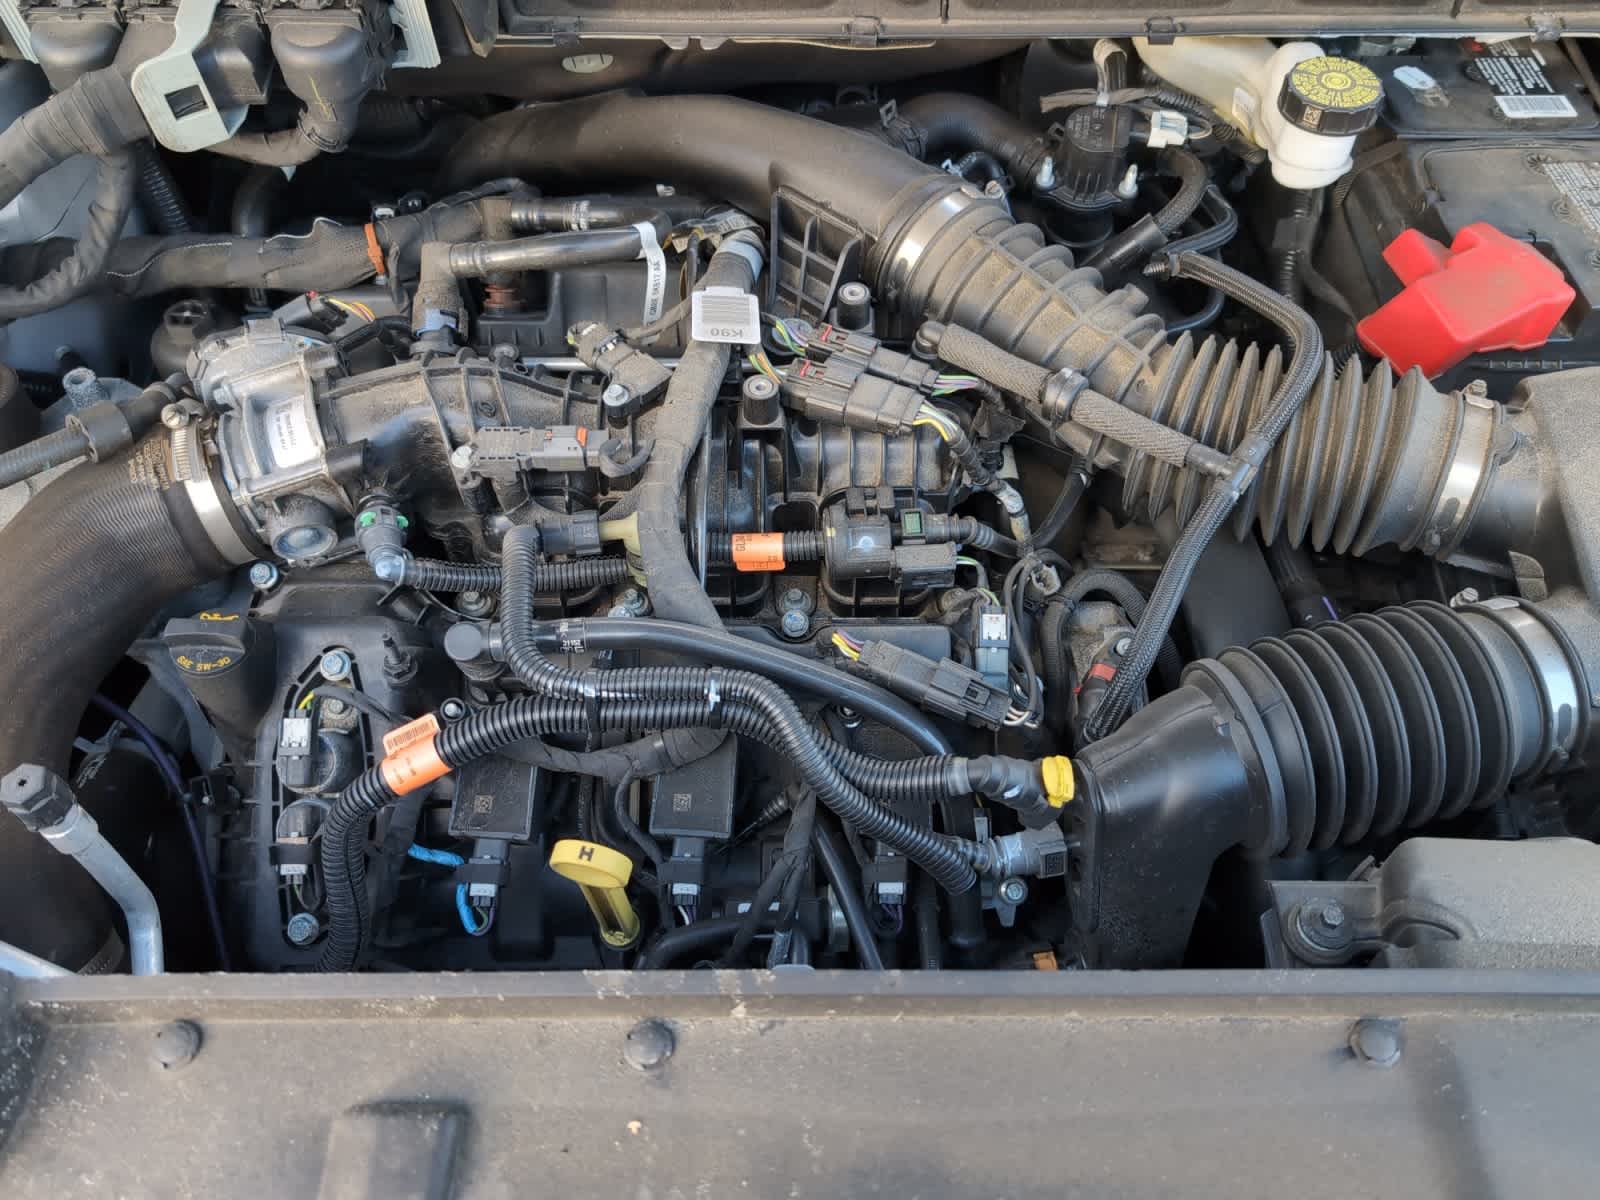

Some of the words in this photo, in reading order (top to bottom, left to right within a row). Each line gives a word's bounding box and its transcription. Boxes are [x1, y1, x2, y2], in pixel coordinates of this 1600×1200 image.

[710, 328, 743, 338] K90
[177, 656, 194, 669] SAE
[196, 656, 231, 670] 5W-30
[578, 844, 594, 862] H
